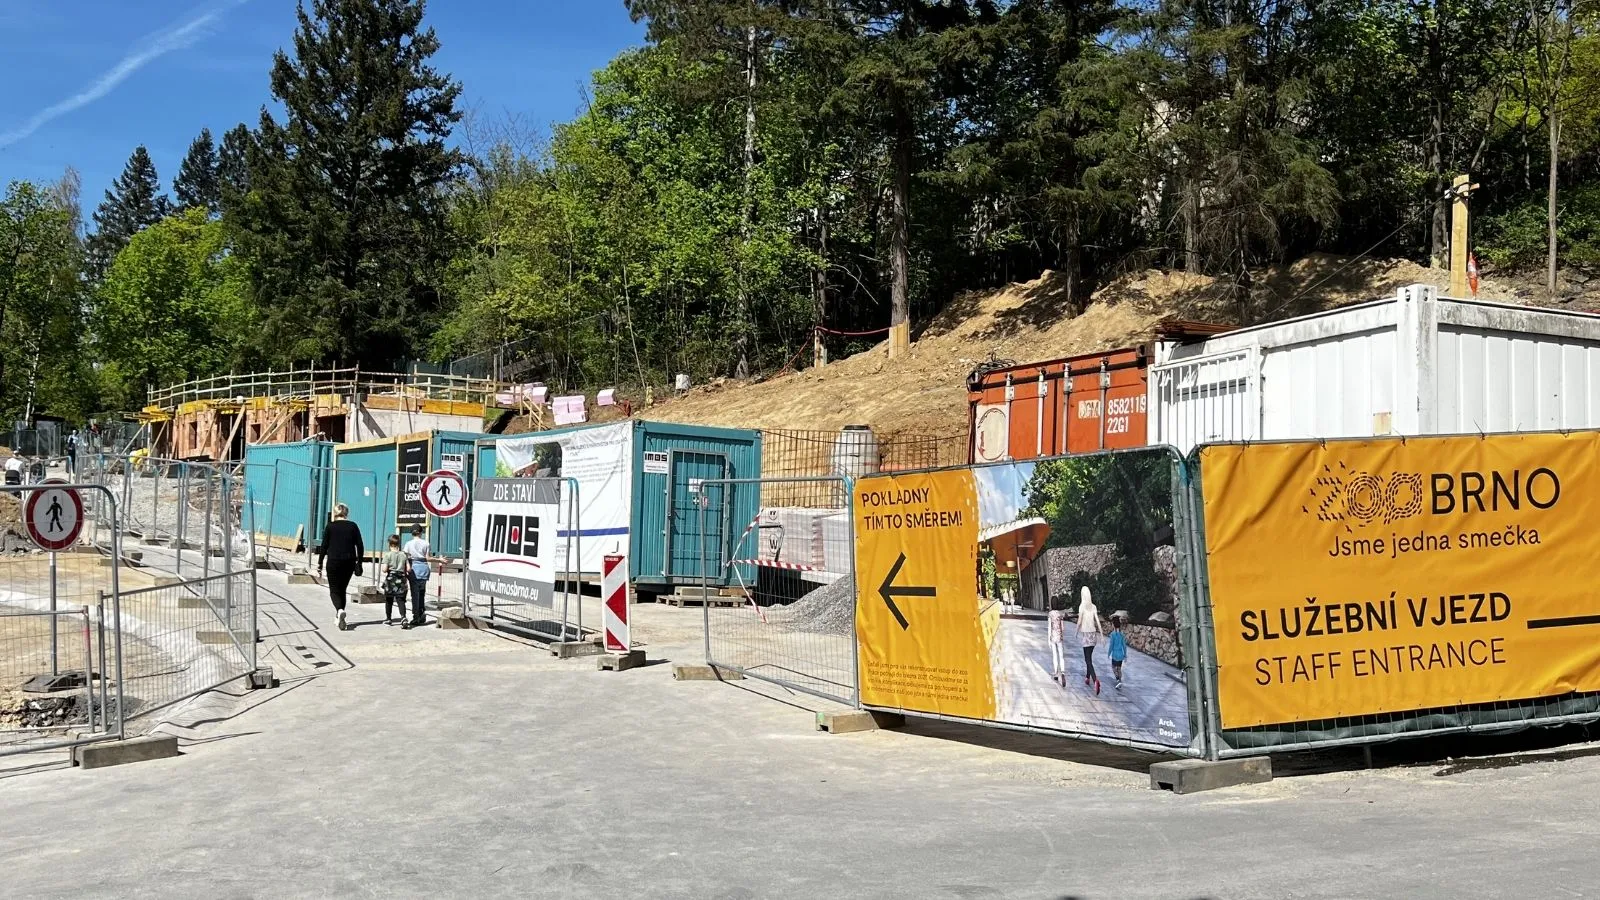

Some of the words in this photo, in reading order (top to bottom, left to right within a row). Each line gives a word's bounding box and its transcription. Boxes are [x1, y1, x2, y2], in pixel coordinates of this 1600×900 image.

[1108, 394, 1146, 415] 8582119
[1106, 416, 1129, 433] 22G1
[644, 453, 668, 462] IMOS
[493, 483, 509, 500] ZDE
[511, 480, 537, 502] STAVÍ
[861, 488, 930, 507] POKLADNY
[1430, 467, 1561, 515] BRNO
[864, 512, 903, 530] TÍMTO
[906, 508, 963, 529] SMĚREM!
[484, 514, 540, 558] IMOS
[1329, 535, 1385, 557] Jsme
[1390, 530, 1452, 559] jedna
[1458, 524, 1541, 549] smečka
[480, 579, 539, 601] www.imosbrno.eu
[1240, 590, 1398, 642] SLUŽEBNÍ
[1406, 591, 1511, 628] VJEZD
[1255, 651, 1342, 686] STAFF
[1352, 637, 1507, 677] ENTRANCE
[1158, 718, 1176, 728] Arch.
[1159, 729, 1183, 740] Design
